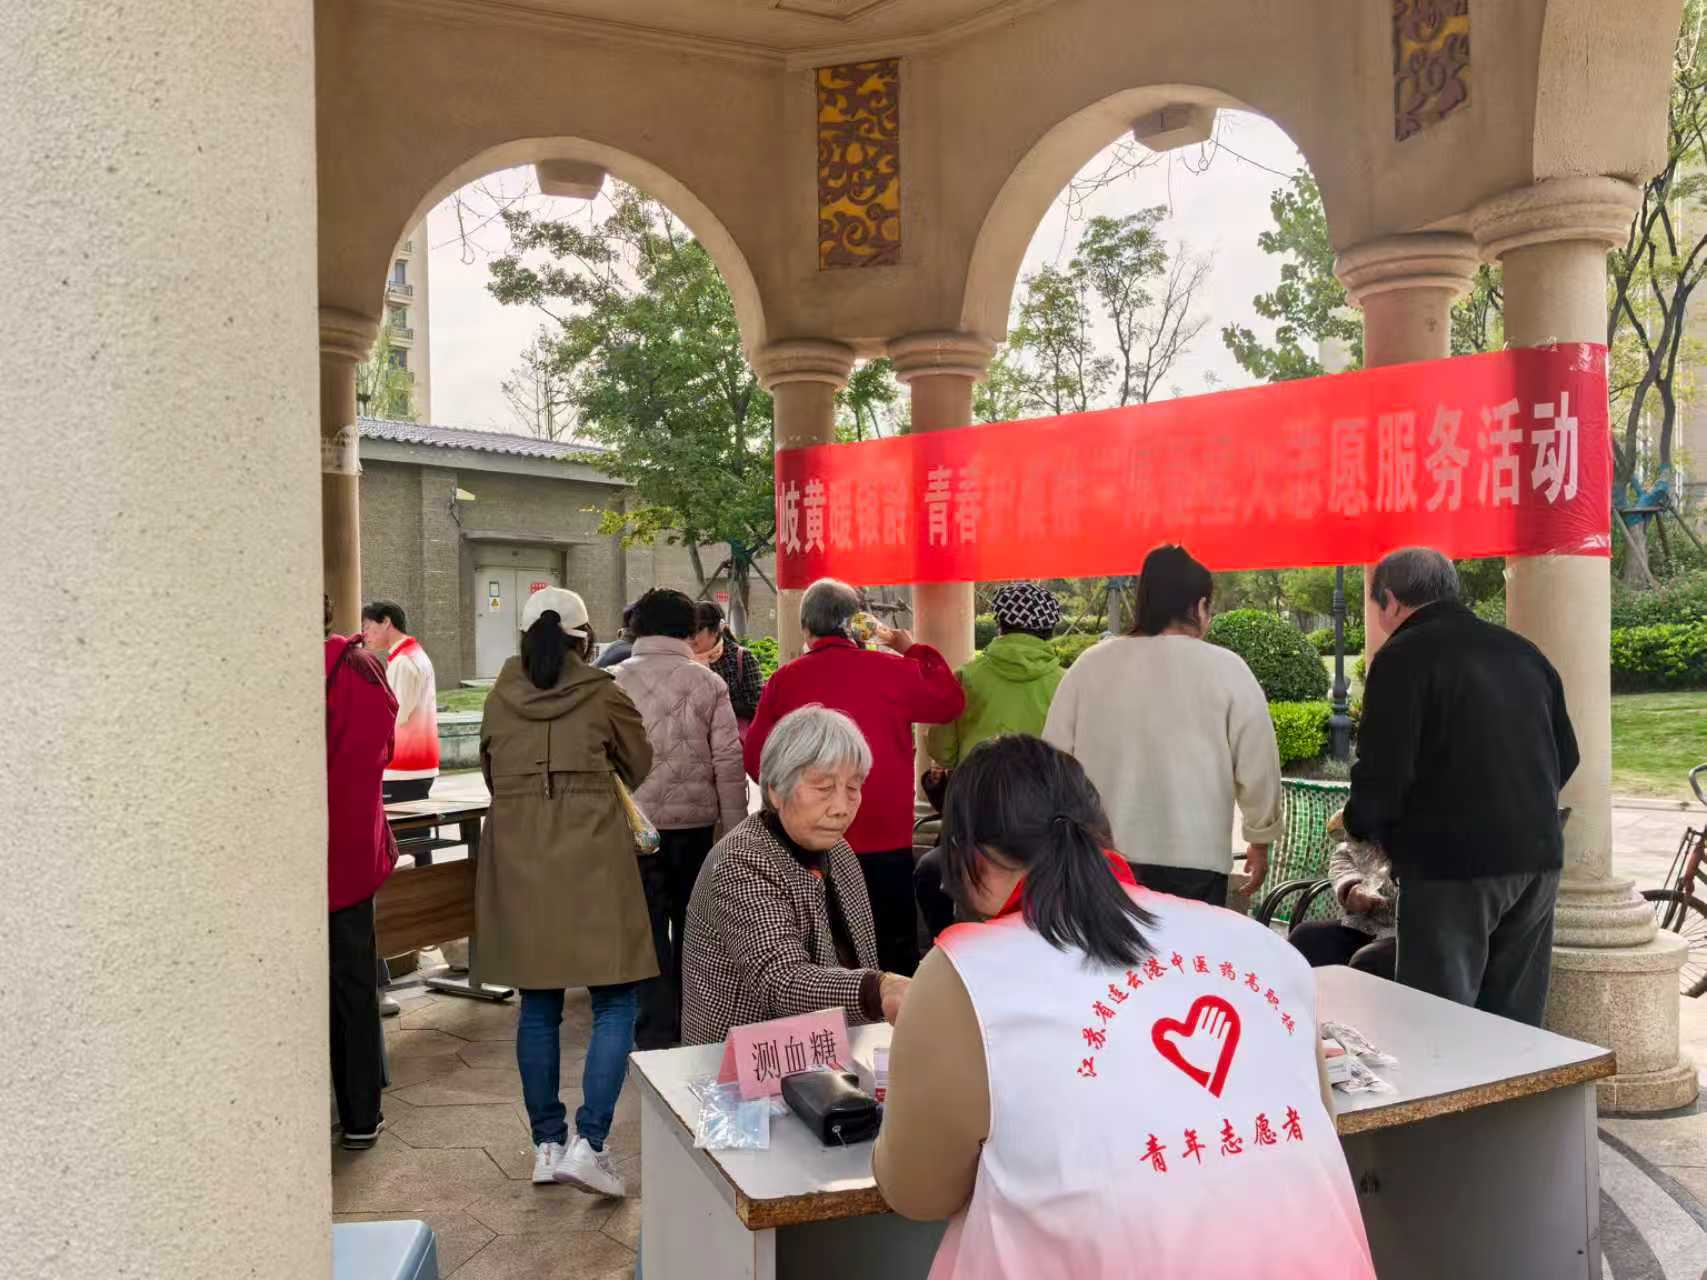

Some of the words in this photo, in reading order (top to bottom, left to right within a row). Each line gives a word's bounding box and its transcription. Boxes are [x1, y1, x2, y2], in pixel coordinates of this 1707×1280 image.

[752, 1028, 837, 1082] 测血糖
[1140, 1105, 1303, 1172] 青年志愿者
